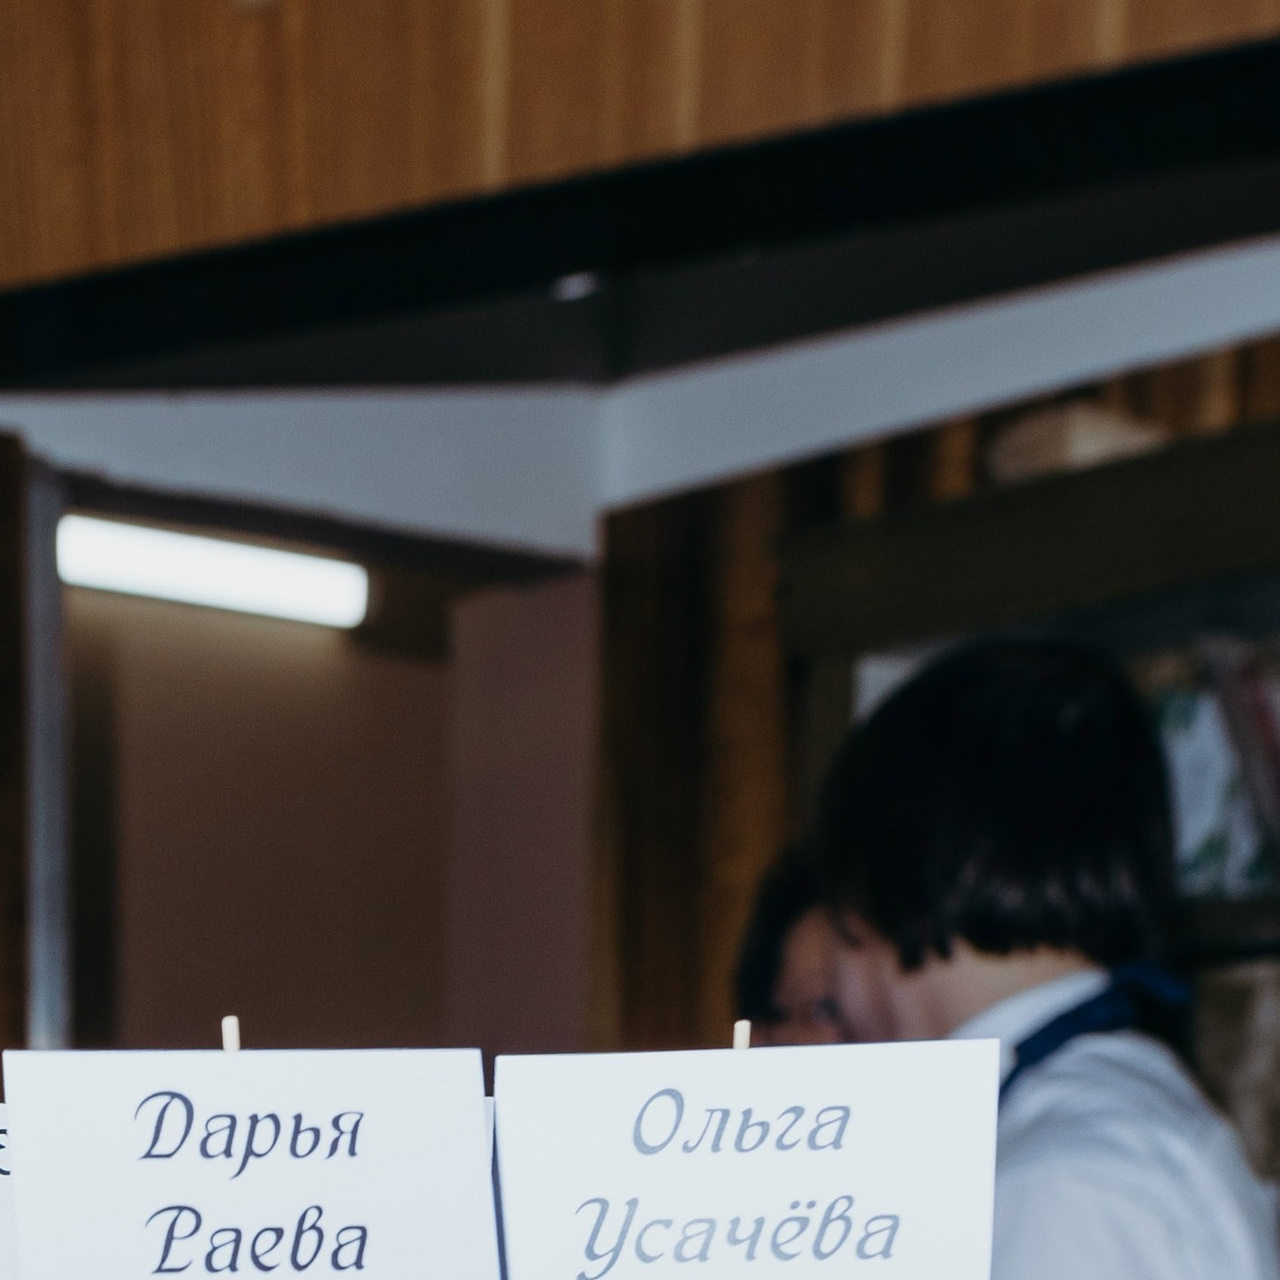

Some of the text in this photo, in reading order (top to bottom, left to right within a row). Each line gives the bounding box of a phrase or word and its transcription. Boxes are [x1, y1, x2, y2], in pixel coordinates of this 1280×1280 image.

[133, 1090, 365, 1180] Дарья
[632, 1087, 852, 1156] Ольга
[144, 1204, 369, 1275] Раева
